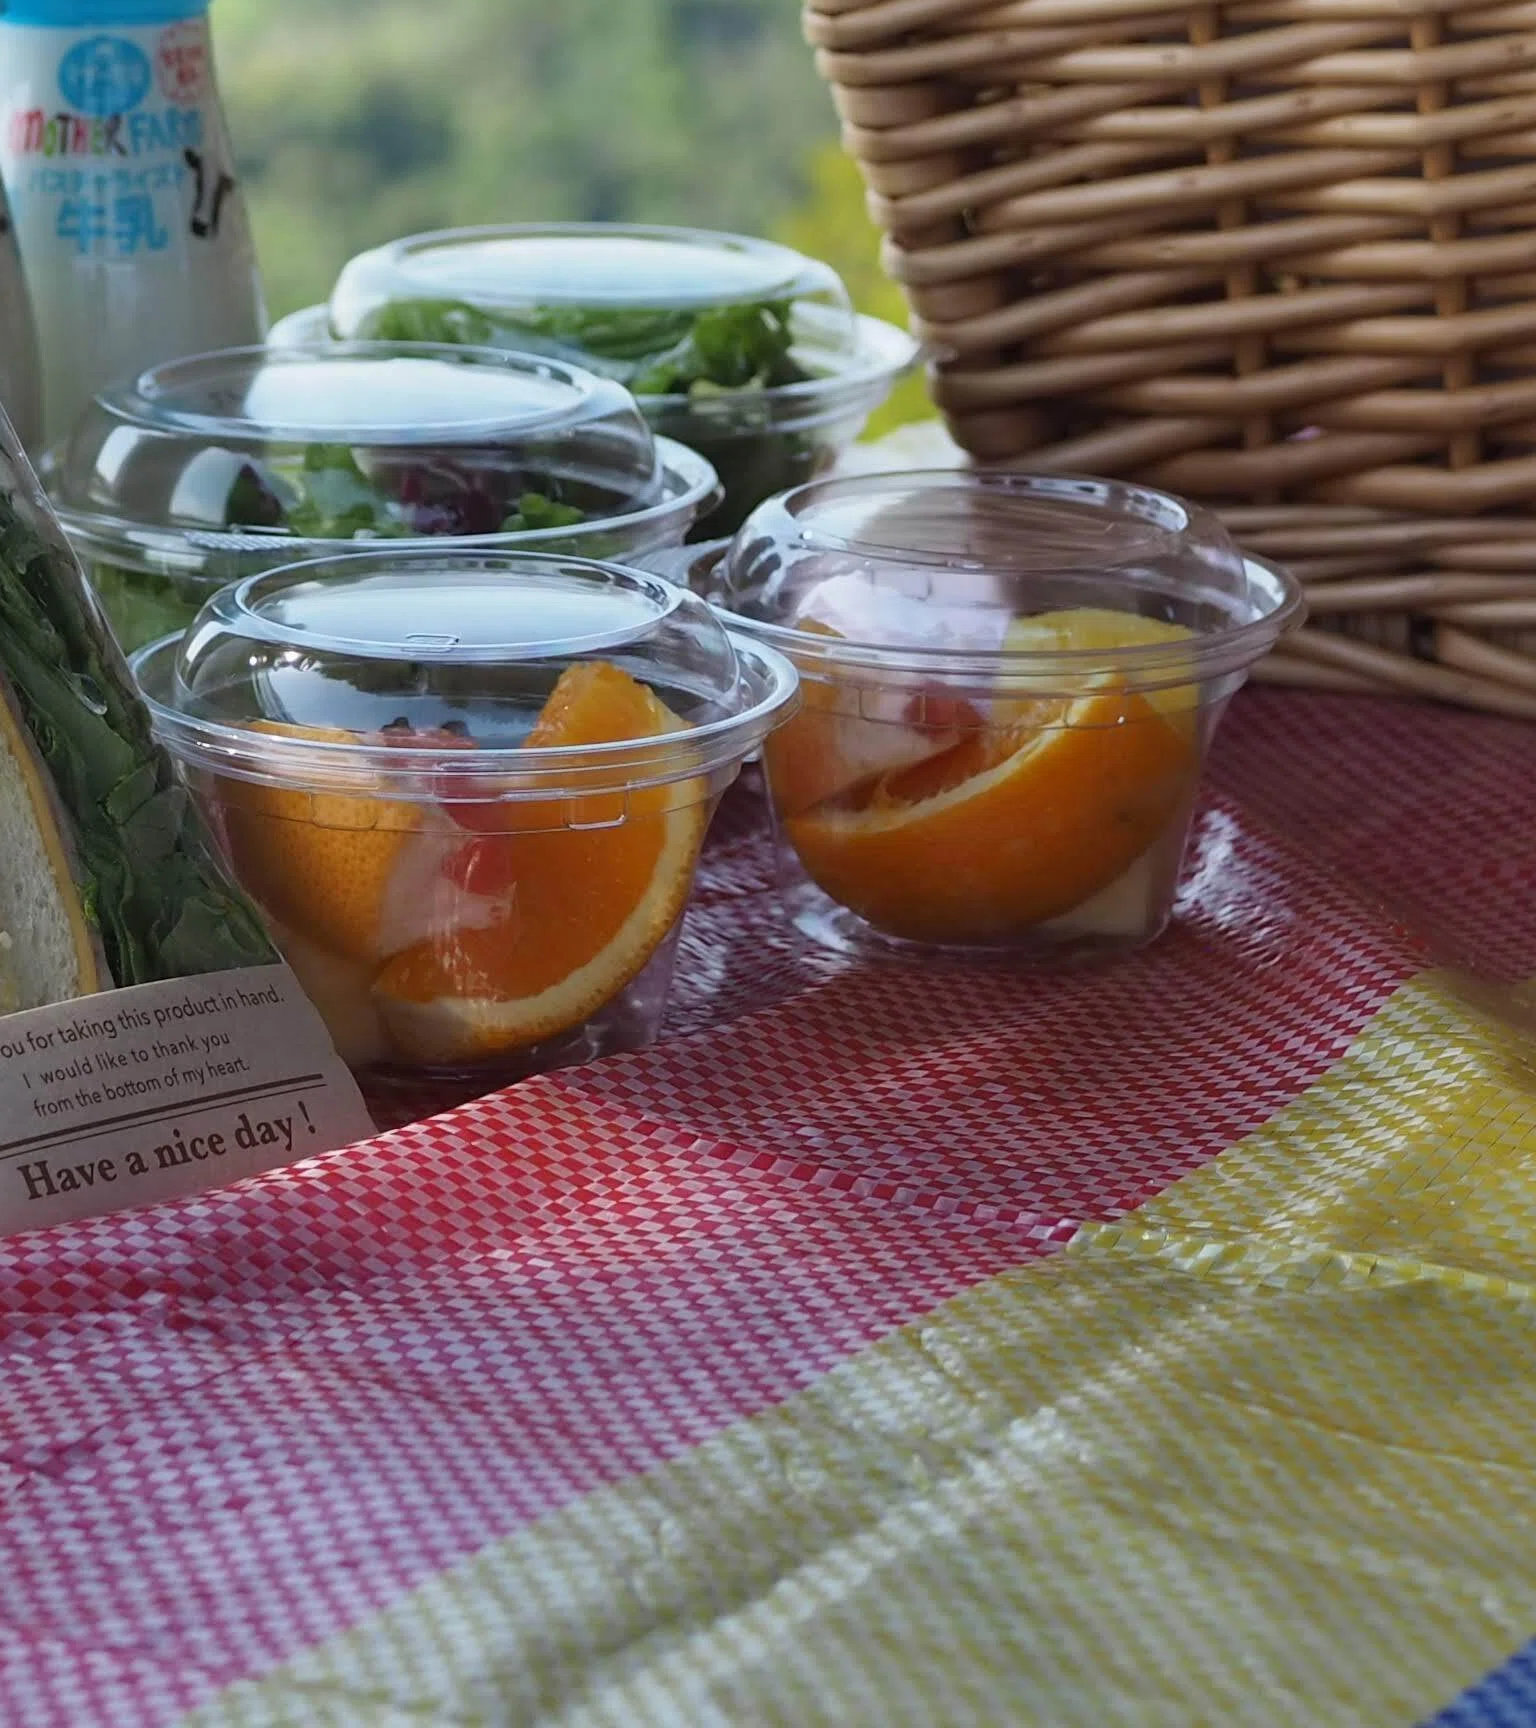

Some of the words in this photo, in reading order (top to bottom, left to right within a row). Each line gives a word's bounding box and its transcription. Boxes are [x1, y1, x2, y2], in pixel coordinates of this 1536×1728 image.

[10, 107, 127, 158] MOTHER
[128, 107, 202, 155] FARM
[56, 195, 169, 255] 牛乳
[26, 1030, 56, 1052] for
[57, 1015, 118, 1044] taking
[117, 1008, 151, 1031] this
[154, 997, 219, 1028] product
[218, 992, 238, 1011] in
[236, 983, 285, 1008] hand.
[22, 1073, 32, 1089] I
[40, 1057, 93, 1085] would
[95, 1051, 128, 1073] like
[130, 1046, 149, 1064] to
[151, 1035, 199, 1060] thank
[201, 1031, 231, 1054] you
[33, 1098, 74, 1118] from
[75, 1090, 103, 1108] the
[102, 1077, 162, 1101] bottom
[164, 1067, 180, 1088] of
[182, 1068, 205, 1086] my
[205, 1056, 251, 1079] heart.
[16, 1158, 118, 1201] Have
[124, 1150, 150, 1176] a
[153, 1128, 227, 1169] nice
[234, 1112, 293, 1152] day
